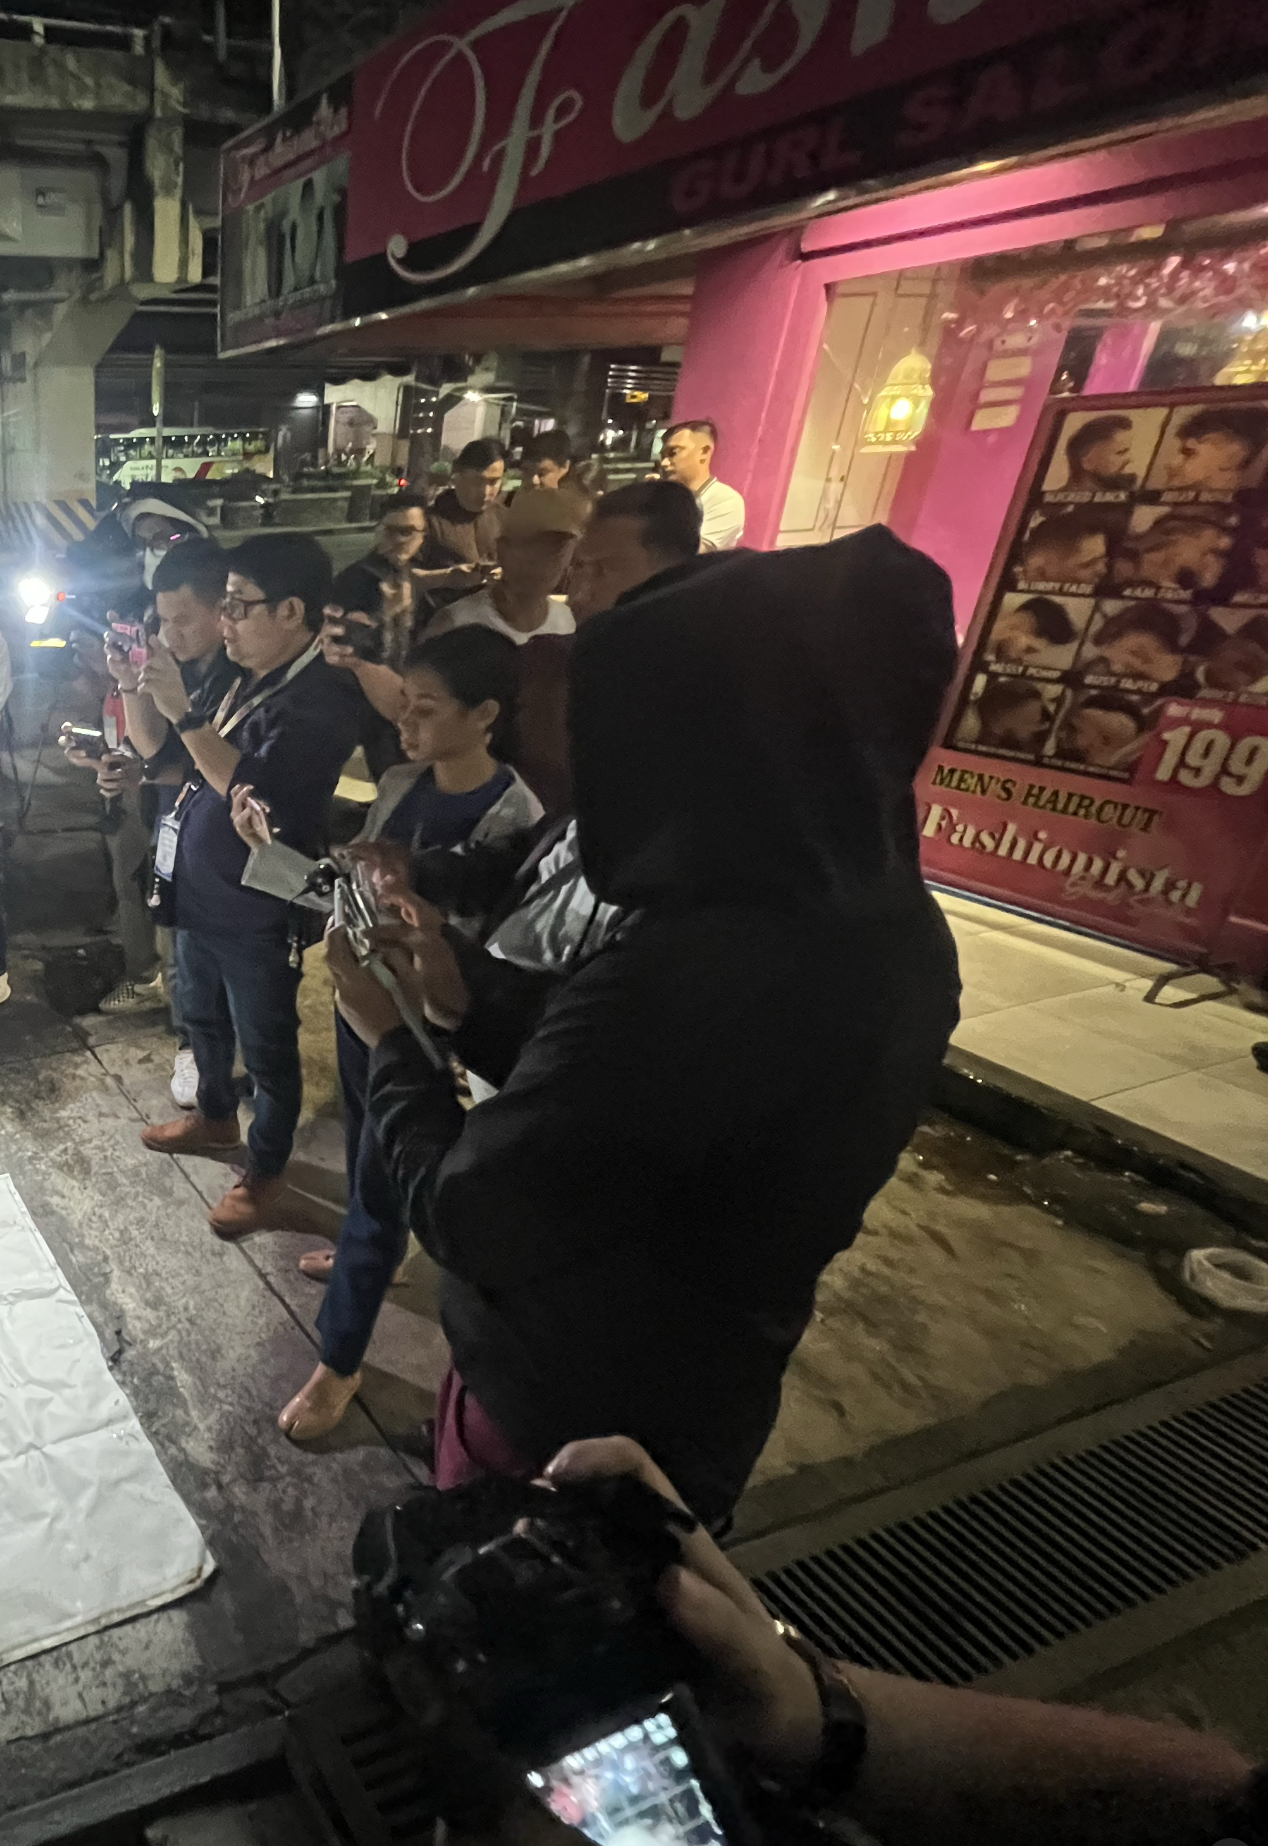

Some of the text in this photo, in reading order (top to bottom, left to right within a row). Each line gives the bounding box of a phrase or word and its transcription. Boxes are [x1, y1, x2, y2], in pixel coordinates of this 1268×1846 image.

[669, 117, 862, 214] GURL
[931, 764, 1018, 802] MEN'S
[1020, 783, 1163, 834] HAIRCUT
[1154, 725, 1268, 796] 199
[920, 802, 1203, 908] Fashionista
